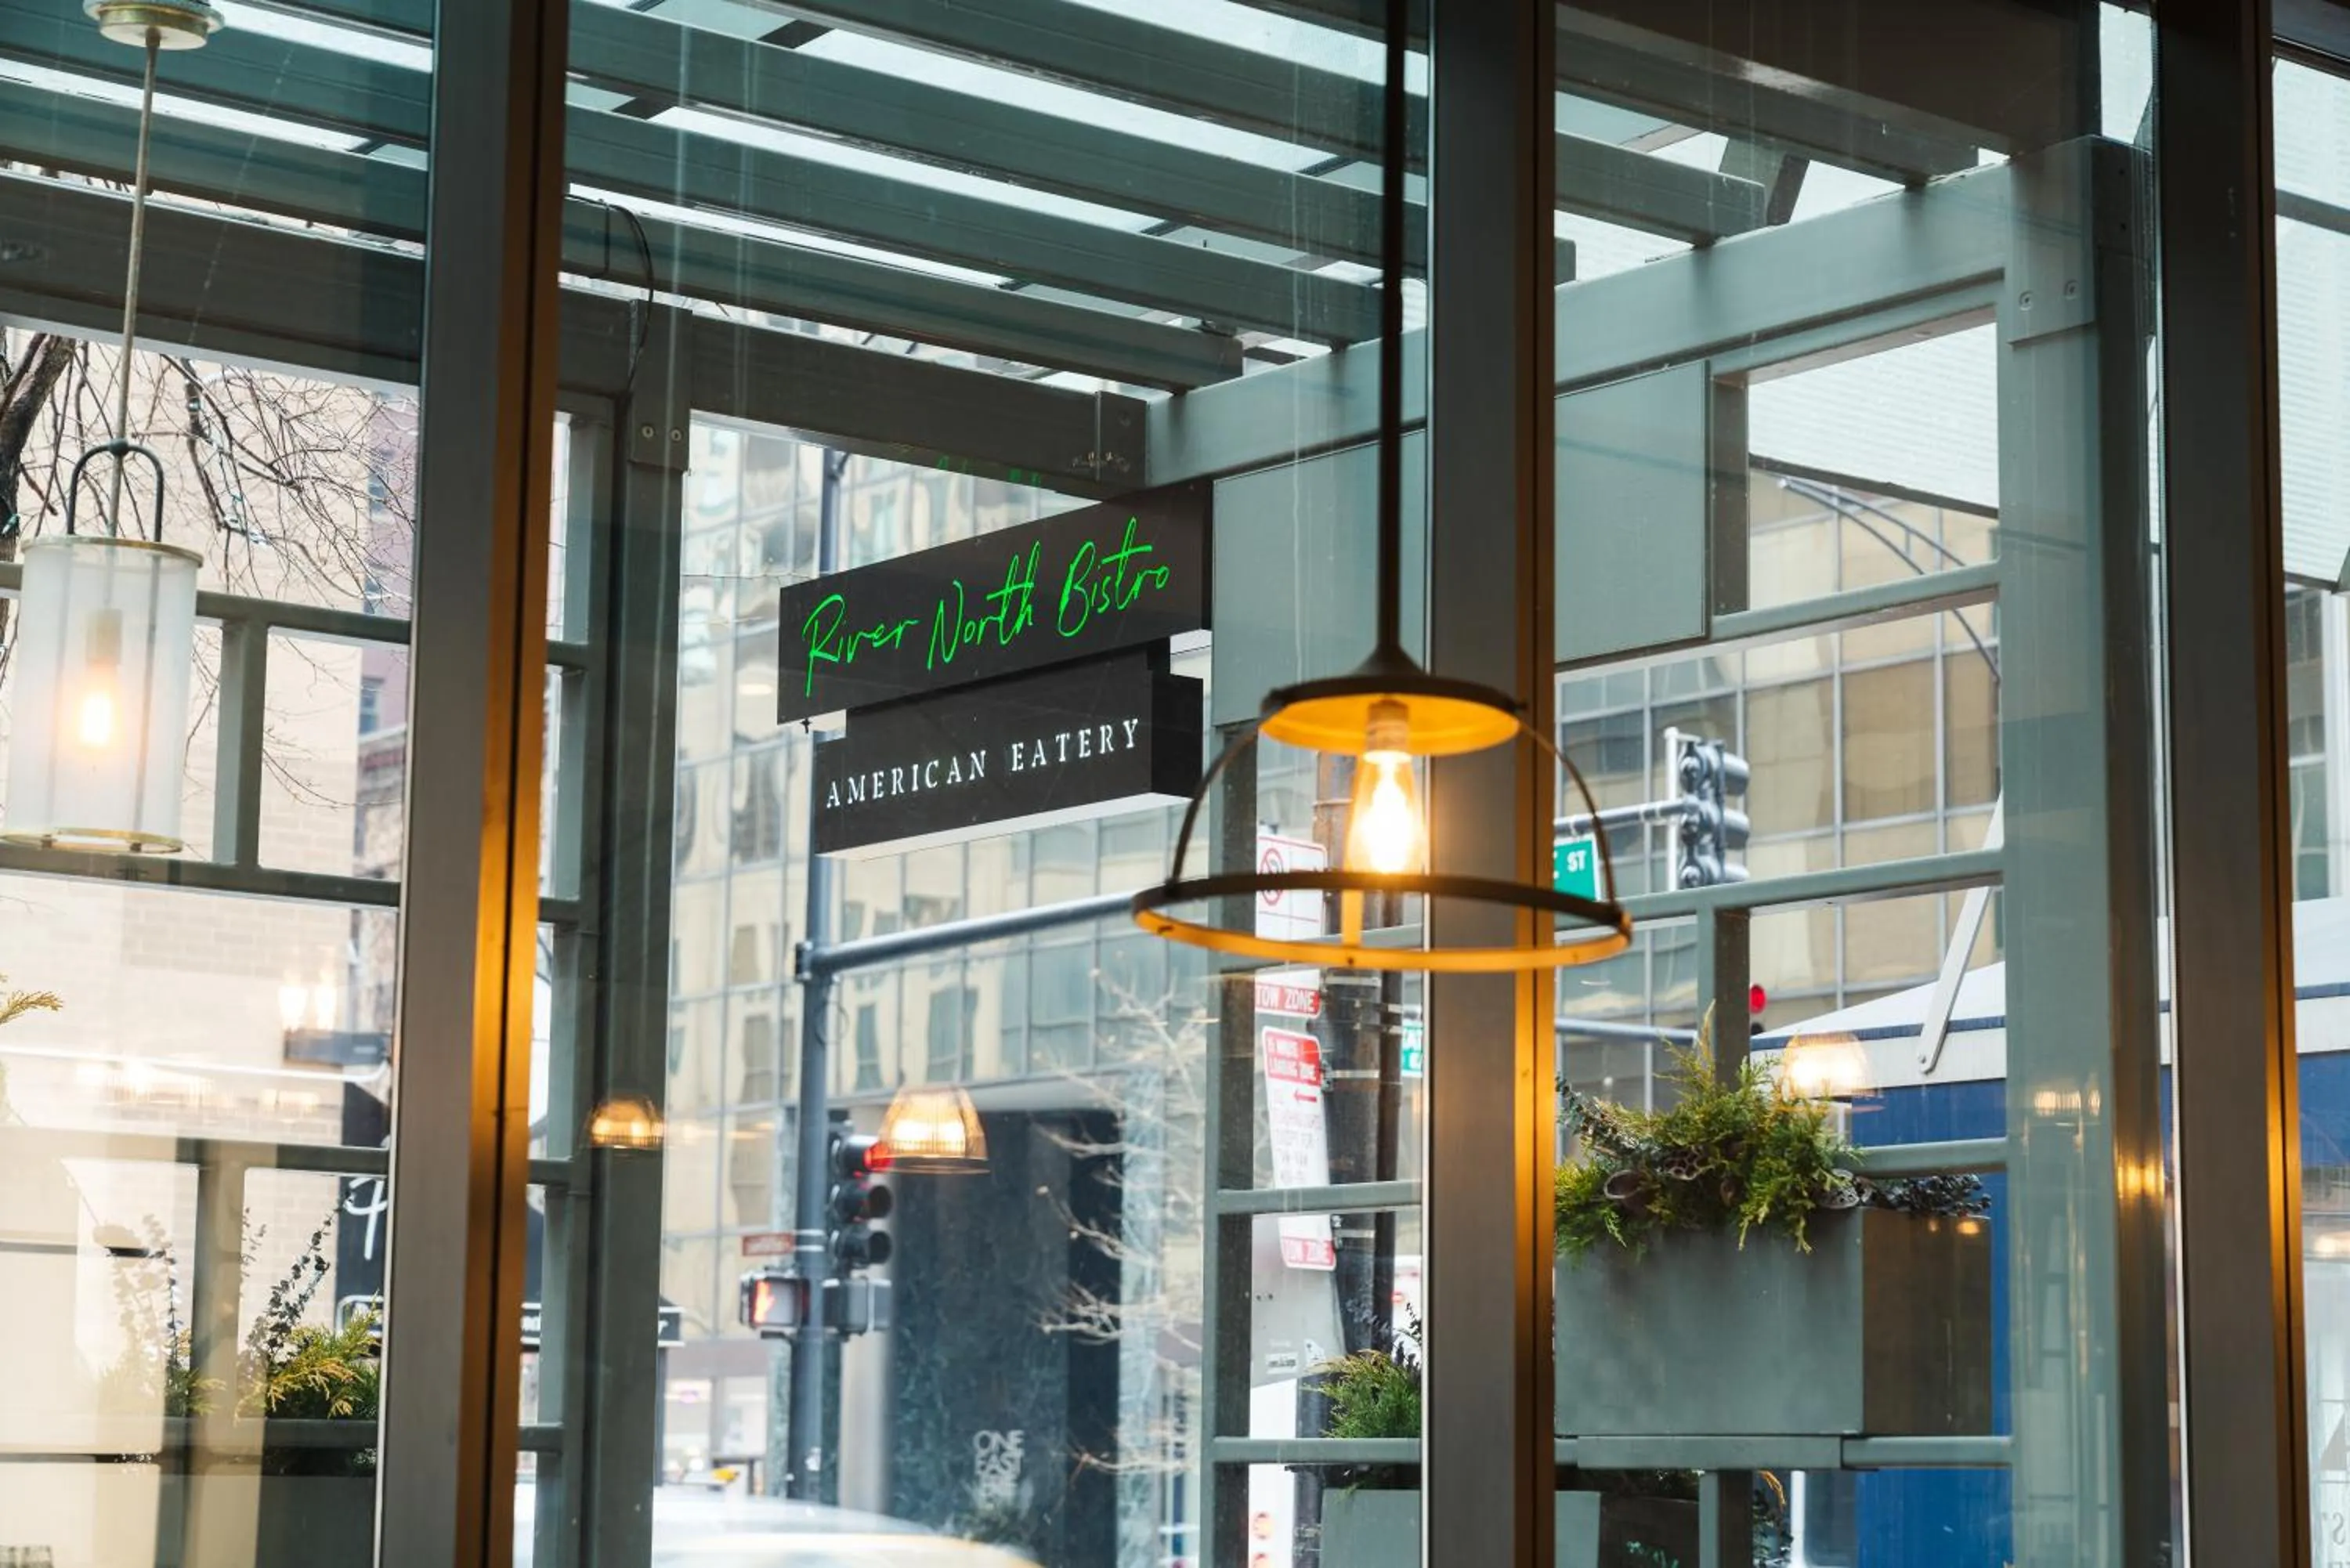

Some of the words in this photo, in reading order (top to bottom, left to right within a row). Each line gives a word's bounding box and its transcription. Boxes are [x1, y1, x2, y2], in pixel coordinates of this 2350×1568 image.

[801, 593, 918, 695] River
[926, 540, 1042, 670] North
[1057, 517, 1170, 638] Bistro
[826, 750, 987, 809] AMERICAN
[1010, 717, 1140, 771] EATERY
[1567, 850, 1585, 872] ST
[1284, 988, 1314, 1013] ZONE
[973, 1430, 1025, 1456] ONE
